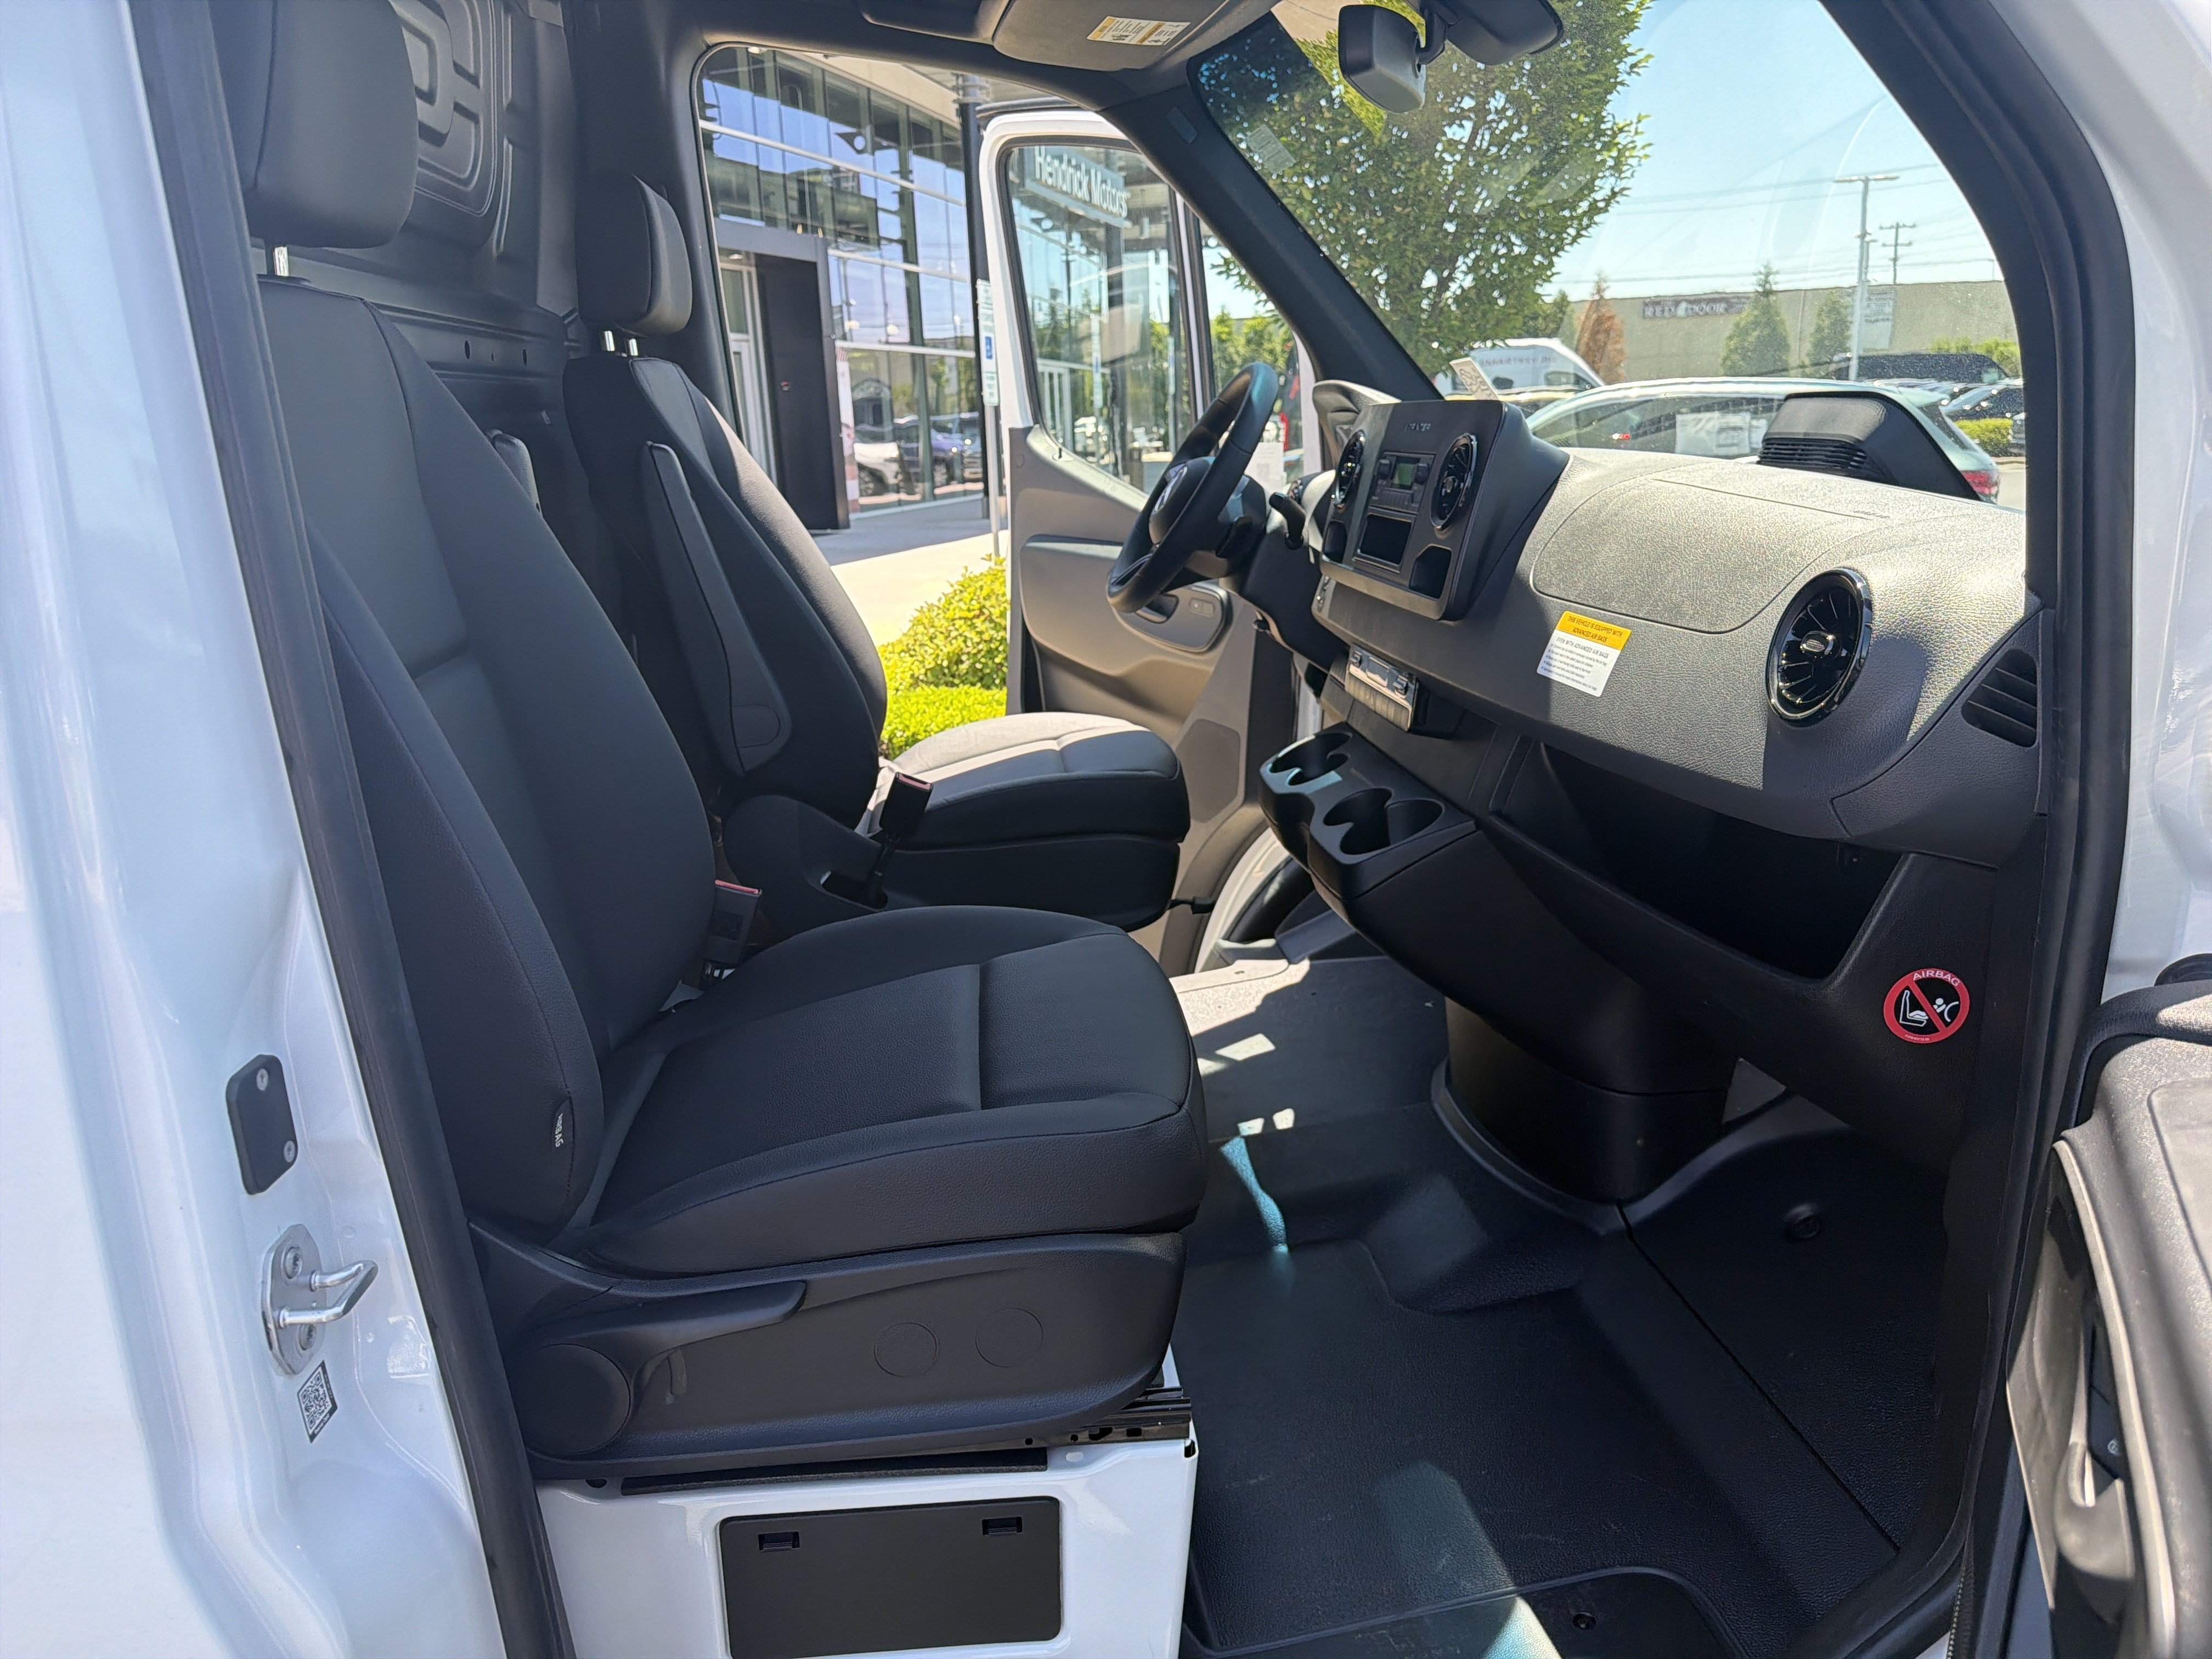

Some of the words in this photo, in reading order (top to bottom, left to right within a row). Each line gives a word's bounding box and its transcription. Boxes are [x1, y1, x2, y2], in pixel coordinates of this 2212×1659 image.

[1035, 146, 1090, 202] Hendrick
[1091, 168, 1128, 218] Motors
[1913, 970, 1960, 987] AIRBAG
